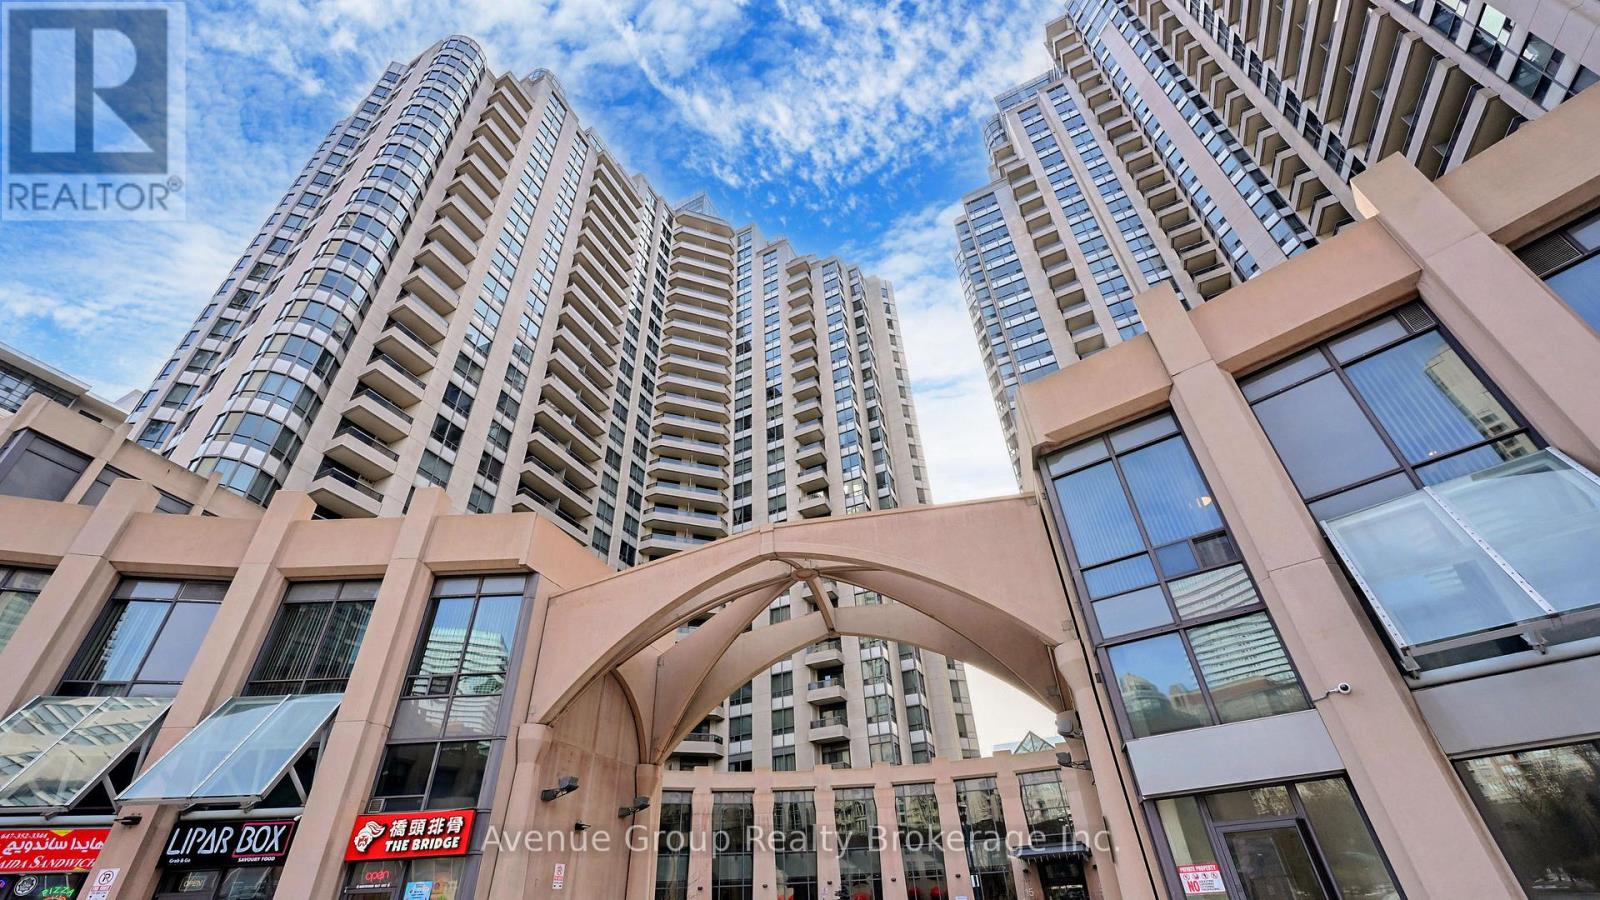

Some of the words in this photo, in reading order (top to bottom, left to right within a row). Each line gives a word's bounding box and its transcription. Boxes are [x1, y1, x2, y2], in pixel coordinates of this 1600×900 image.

[389, 816, 464, 837] 橋頭排骨
[166, 826, 234, 855] LIPAR
[235, 825, 287, 853] BOX
[385, 839, 410, 852] THE
[411, 836, 460, 851] BRIDGE
[0, 855, 29, 869] AIDA
[1187, 880, 1201, 892] NO
